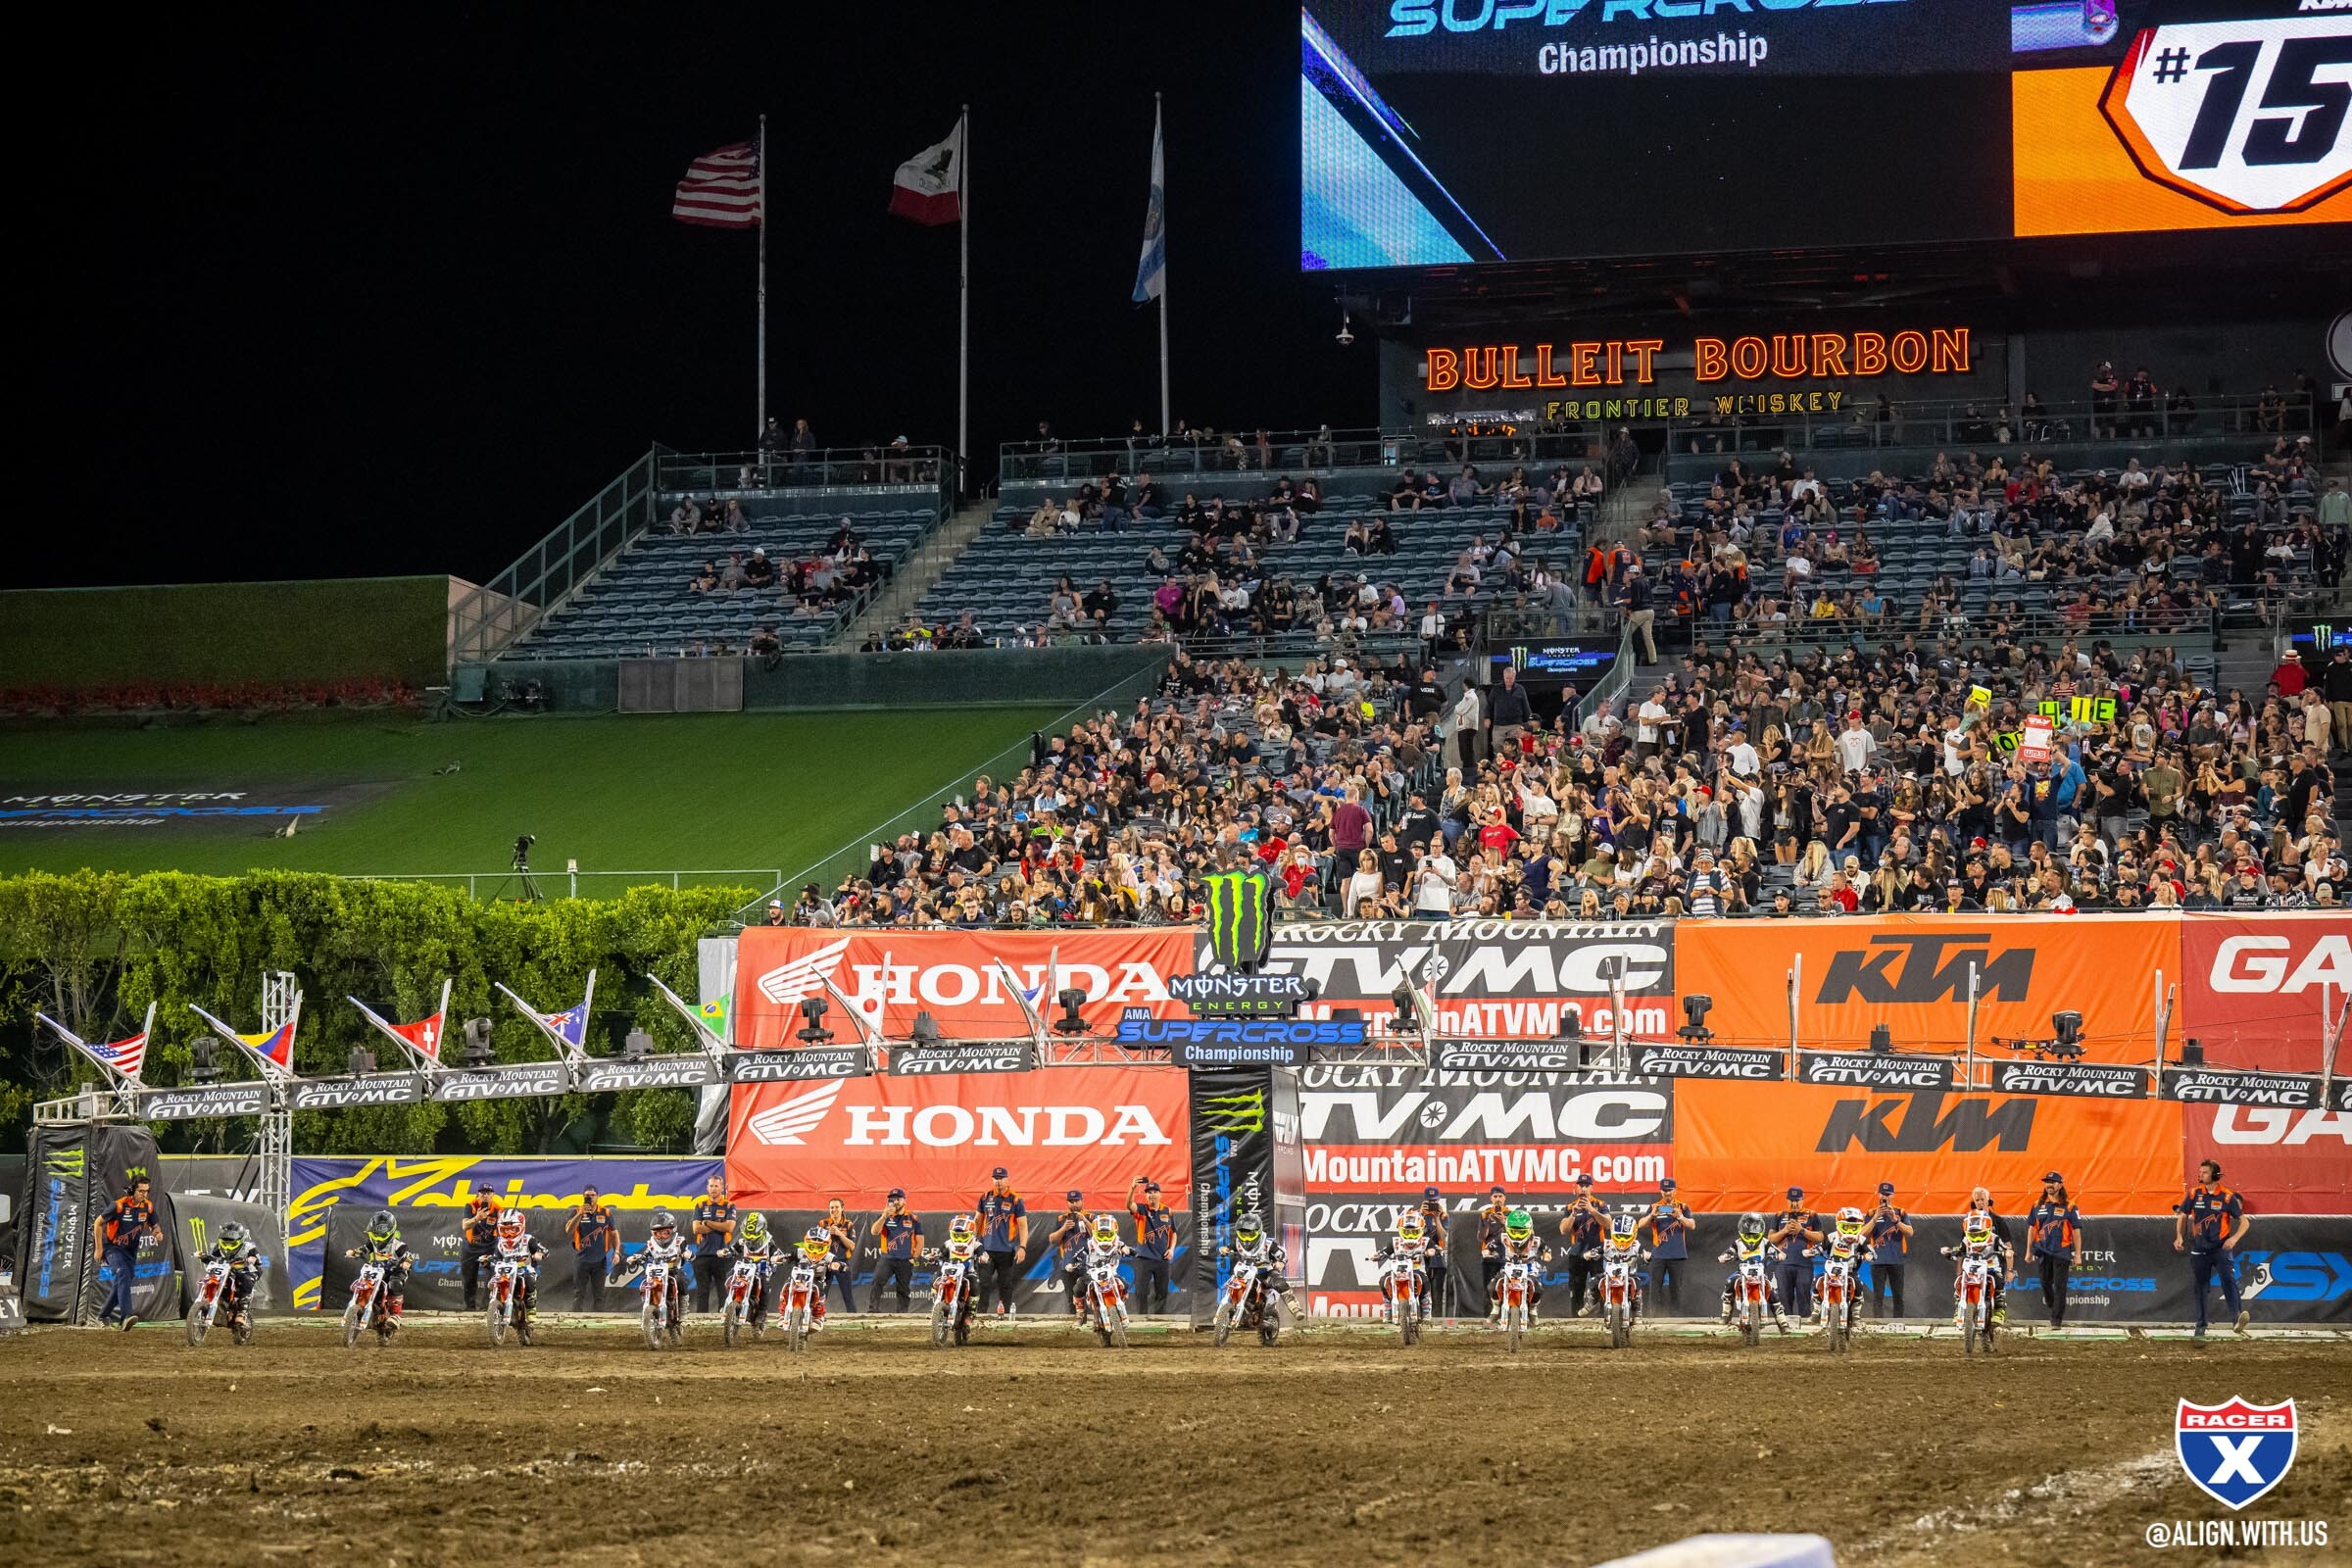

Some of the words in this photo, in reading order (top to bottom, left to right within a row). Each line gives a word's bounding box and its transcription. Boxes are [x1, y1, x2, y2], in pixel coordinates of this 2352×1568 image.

[1540, 31, 1768, 74] Championship
[1427, 339, 1664, 391] BULLEIT
[1694, 328, 1970, 381] BOURBON
[1546, 397, 1690, 420] FRONTIER
[2096, 699, 2112, 721] E
[1273, 920, 1409, 942] ROCKY
[1815, 933, 2036, 1004] KTM
[852, 963, 1175, 1005] HONDA
[1171, 974, 1304, 998] MONSTER
[1125, 1008, 1151, 1020] AMA
[1193, 1001, 1284, 1010] ENERGY
[1116, 1021, 1365, 1044] SUPERCROSS
[917, 1049, 955, 1059] ROCKY
[957, 1048, 1022, 1058] MOUNTAIN
[1185, 1045, 1294, 1063] Championship
[1459, 1042, 1501, 1054] ROCKY
[1501, 1042, 1568, 1054] MOUNTAIN
[1662, 1048, 1704, 1059] ROCKY
[1705, 1050, 1772, 1063] MOUNTAIN
[753, 1054, 790, 1064] ROCKY
[792, 1052, 856, 1063] MOUNTAIN
[1831, 1056, 1873, 1069] ROCKY
[1873, 1058, 1942, 1071] MOUNTAIN
[460, 1072, 496, 1084] ROCKY
[498, 1069, 560, 1082] MOUNTAIN
[607, 1063, 643, 1075] ROCKY
[644, 1060, 708, 1072] MOUNTAIN
[2025, 1063, 2067, 1076] ROCKY
[2068, 1066, 2136, 1080] MOUNTAIN
[316, 1080, 352, 1093] ROCKY
[352, 1078, 414, 1091] MOUNTAIN
[2195, 1073, 2237, 1086] ROCKY
[2239, 1076, 2311, 1091] MOUNTAIN
[166, 1093, 202, 1103] ROCKY
[203, 1090, 262, 1102] MOUNTAIN
[844, 1104, 1173, 1148] HONDA
[1815, 1086, 2036, 1152] KTM
[1200, 1182, 1211, 1256] Championship
[65, 1204, 78, 1269] MONSTER
